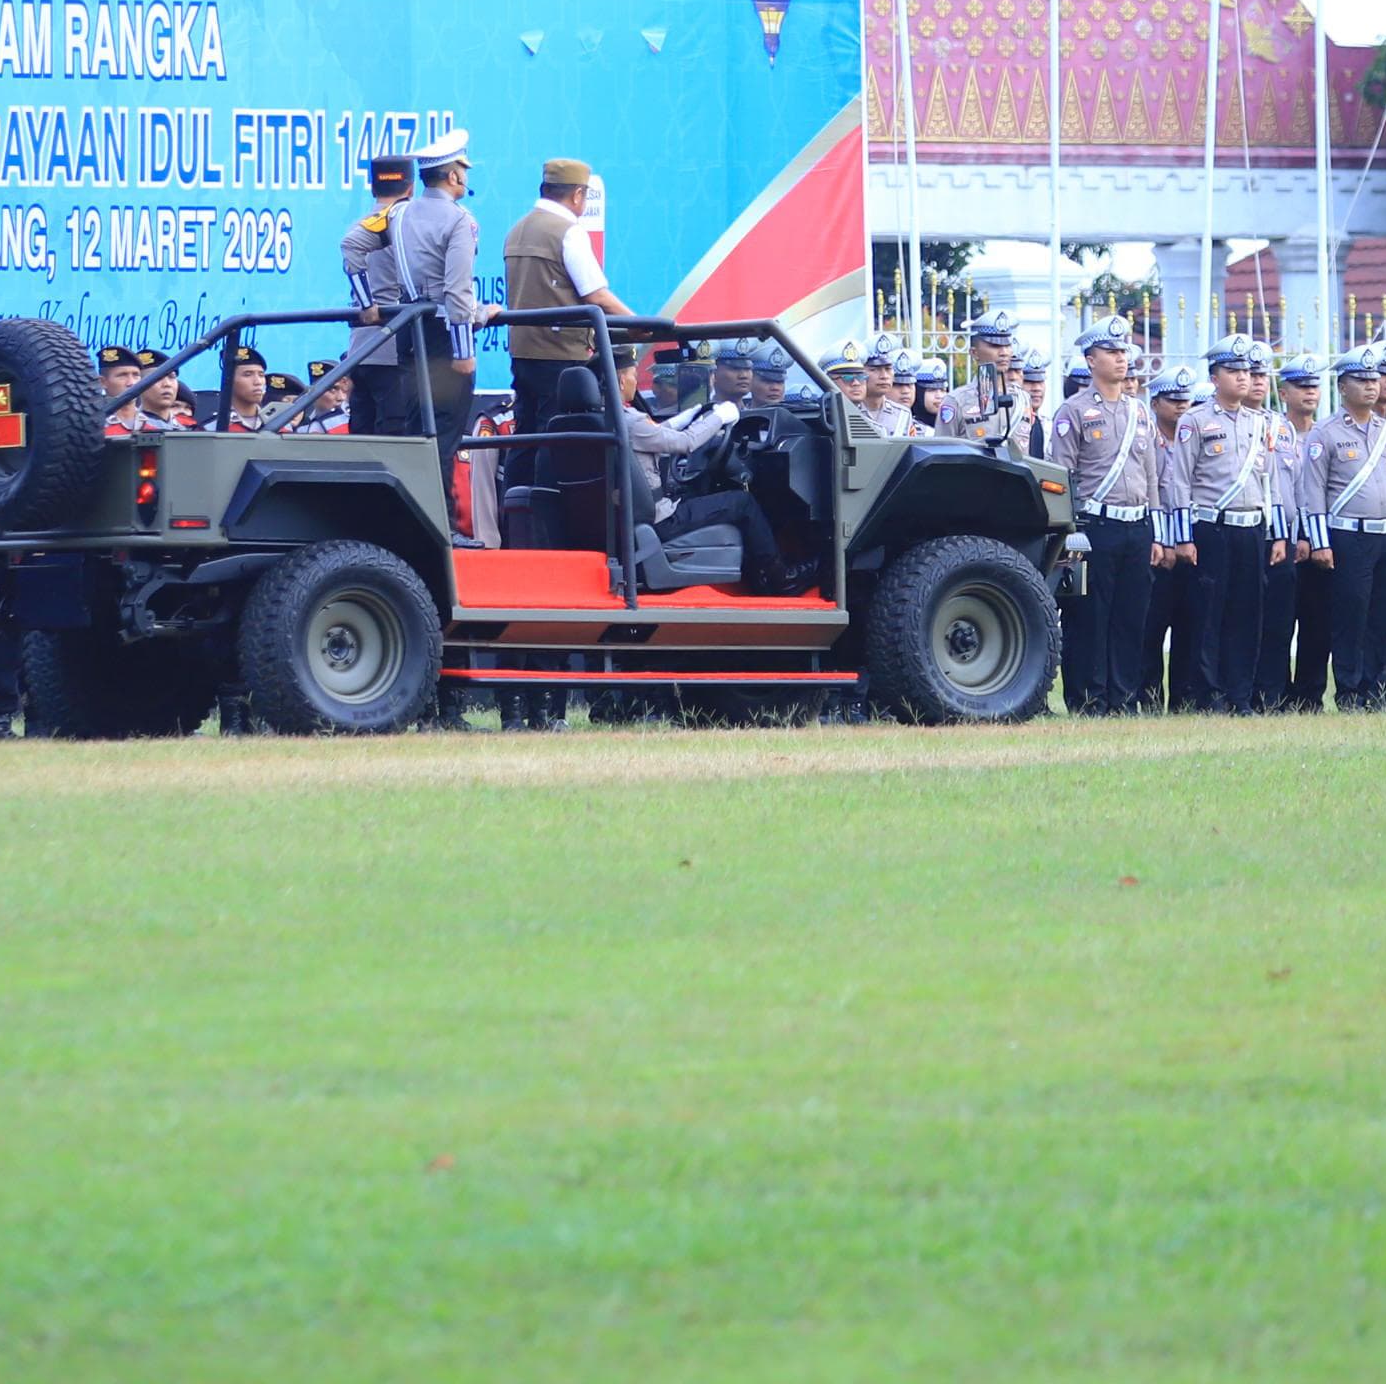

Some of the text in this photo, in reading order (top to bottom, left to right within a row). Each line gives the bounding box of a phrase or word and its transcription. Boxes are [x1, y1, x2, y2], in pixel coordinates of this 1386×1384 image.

[63, 0, 227, 82] RANGKA
[137, 107, 222, 190] IDUL
[231, 109, 326, 191] FITRI
[65, 206, 104, 271] 12
[111, 207, 217, 272] MARET
[223, 208, 294, 274] 2026
